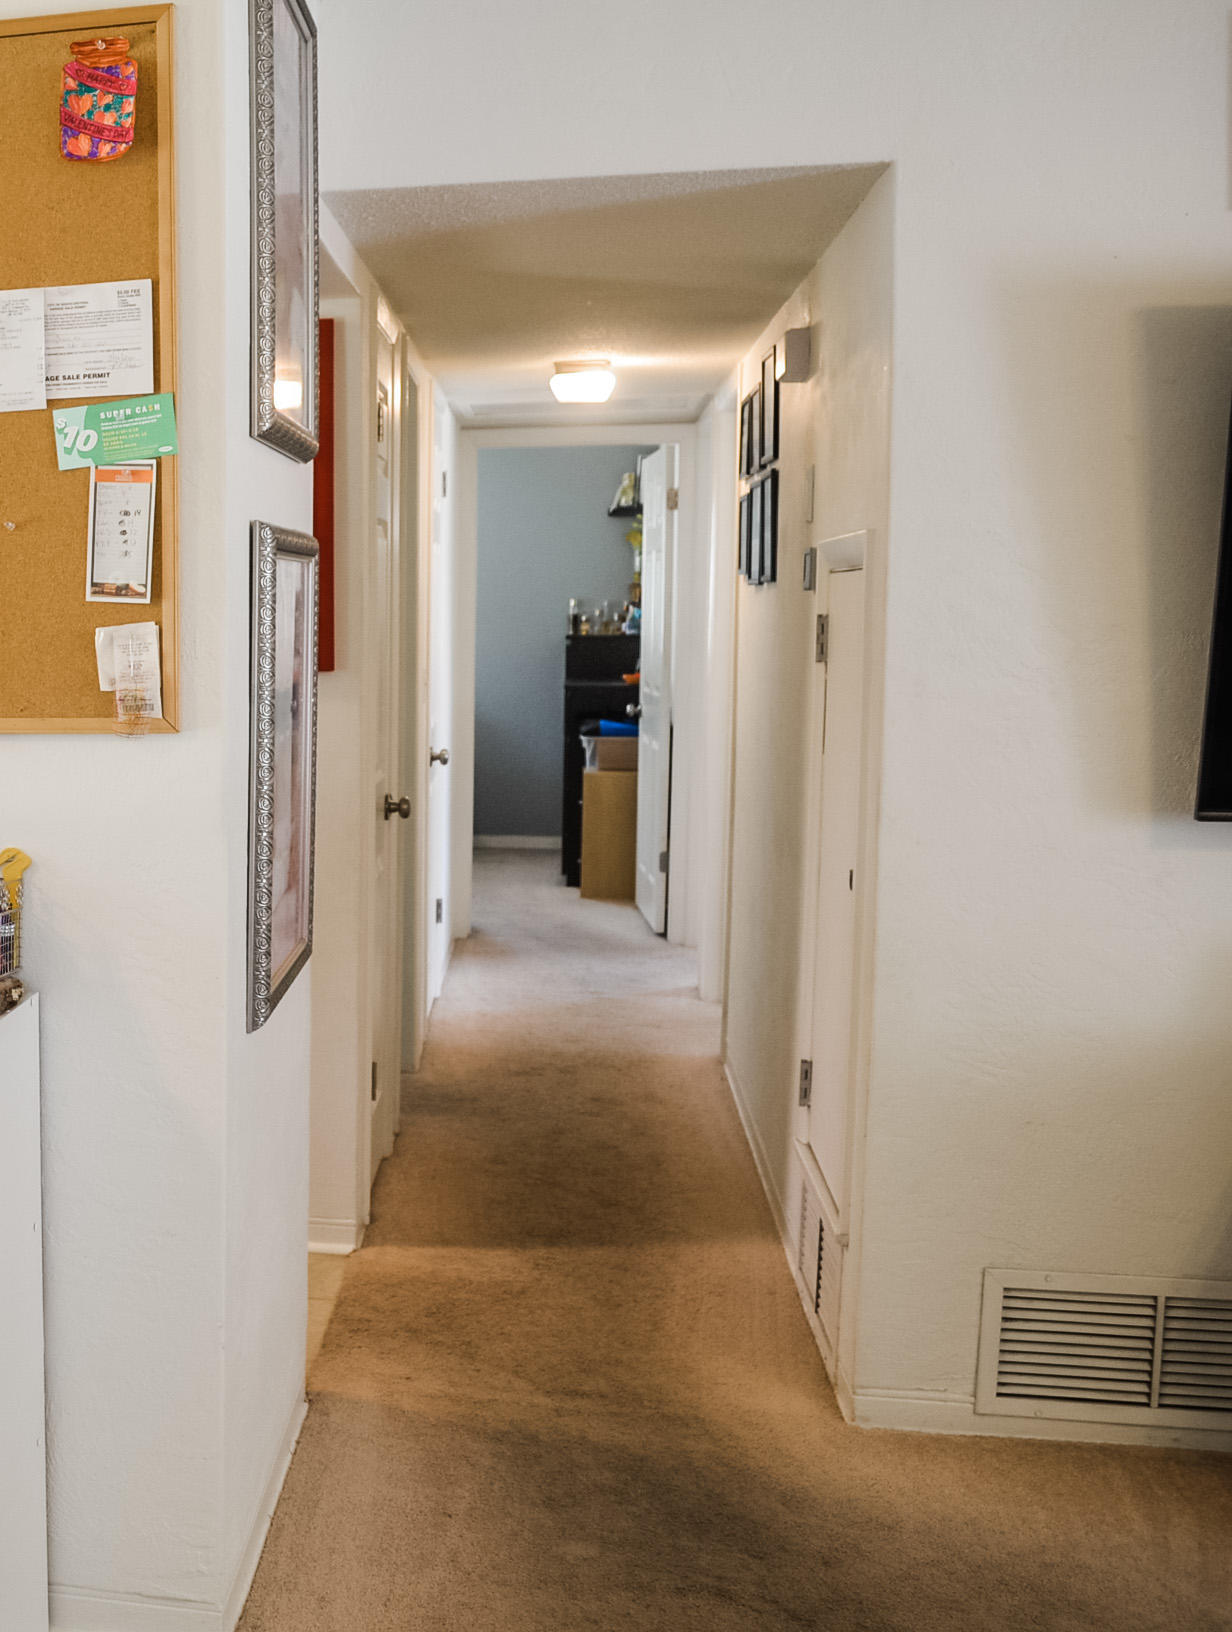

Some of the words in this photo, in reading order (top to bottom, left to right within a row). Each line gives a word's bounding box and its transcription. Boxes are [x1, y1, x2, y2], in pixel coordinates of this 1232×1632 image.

[87, 72, 114, 88] HAPPY
[62, 373, 80, 381] SALE
[83, 372, 111, 380] PERMIT
[100, 407, 132, 419] SUPER
